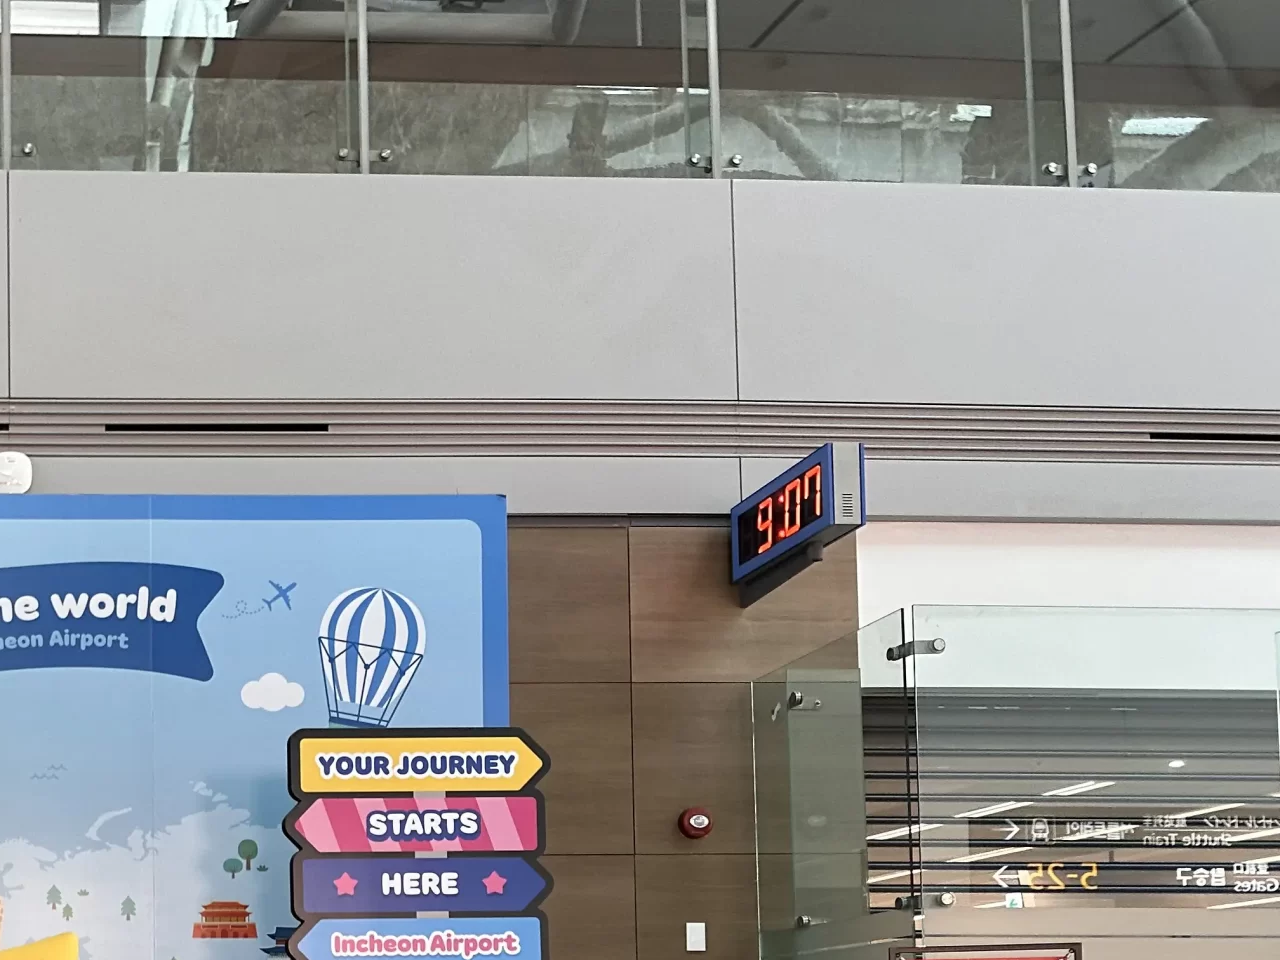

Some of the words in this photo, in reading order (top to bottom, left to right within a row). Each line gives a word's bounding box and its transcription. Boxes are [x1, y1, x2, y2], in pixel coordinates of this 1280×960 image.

[757, 464, 821, 554] 9:07
[50, 586, 177, 624] world
[49, 629, 129, 651] Airport
[318, 755, 390, 776] YOUR
[397, 755, 516, 776] JOURNEY
[369, 812, 479, 835] STARTS
[381, 872, 459, 895] HERE
[334, 935, 430, 953] Incheon
[431, 934, 518, 957] Airport
